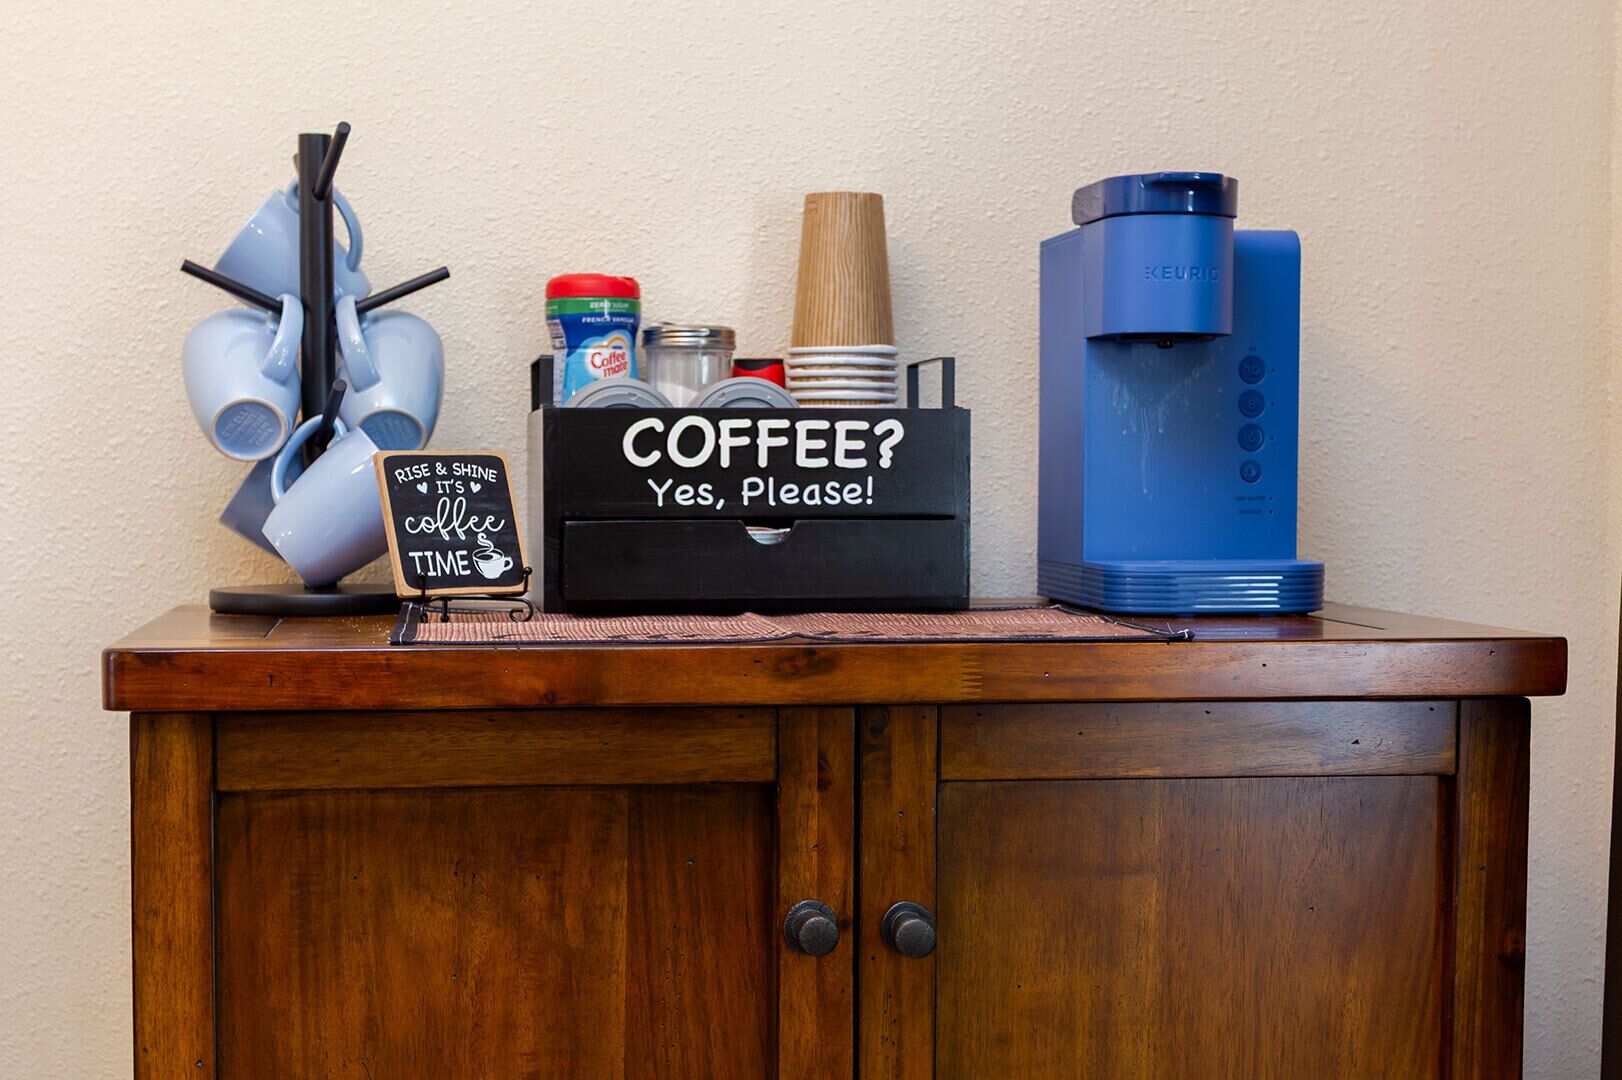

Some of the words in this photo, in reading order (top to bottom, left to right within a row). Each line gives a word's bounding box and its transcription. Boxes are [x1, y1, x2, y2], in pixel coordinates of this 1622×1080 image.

[1145, 266, 1219, 281] KEURIG
[591, 351, 626, 369] Coffee
[603, 361, 628, 378] mate
[622, 415, 905, 469] COFFEE?
[394, 463, 431, 484] RISE
[435, 461, 448, 475] &
[452, 462, 498, 482] SHINE
[435, 478, 465, 494] IT'S
[647, 478, 725, 510] Yes,
[741, 475, 873, 506] Please!
[404, 496, 506, 541] coffee
[408, 550, 472, 577] TIME
